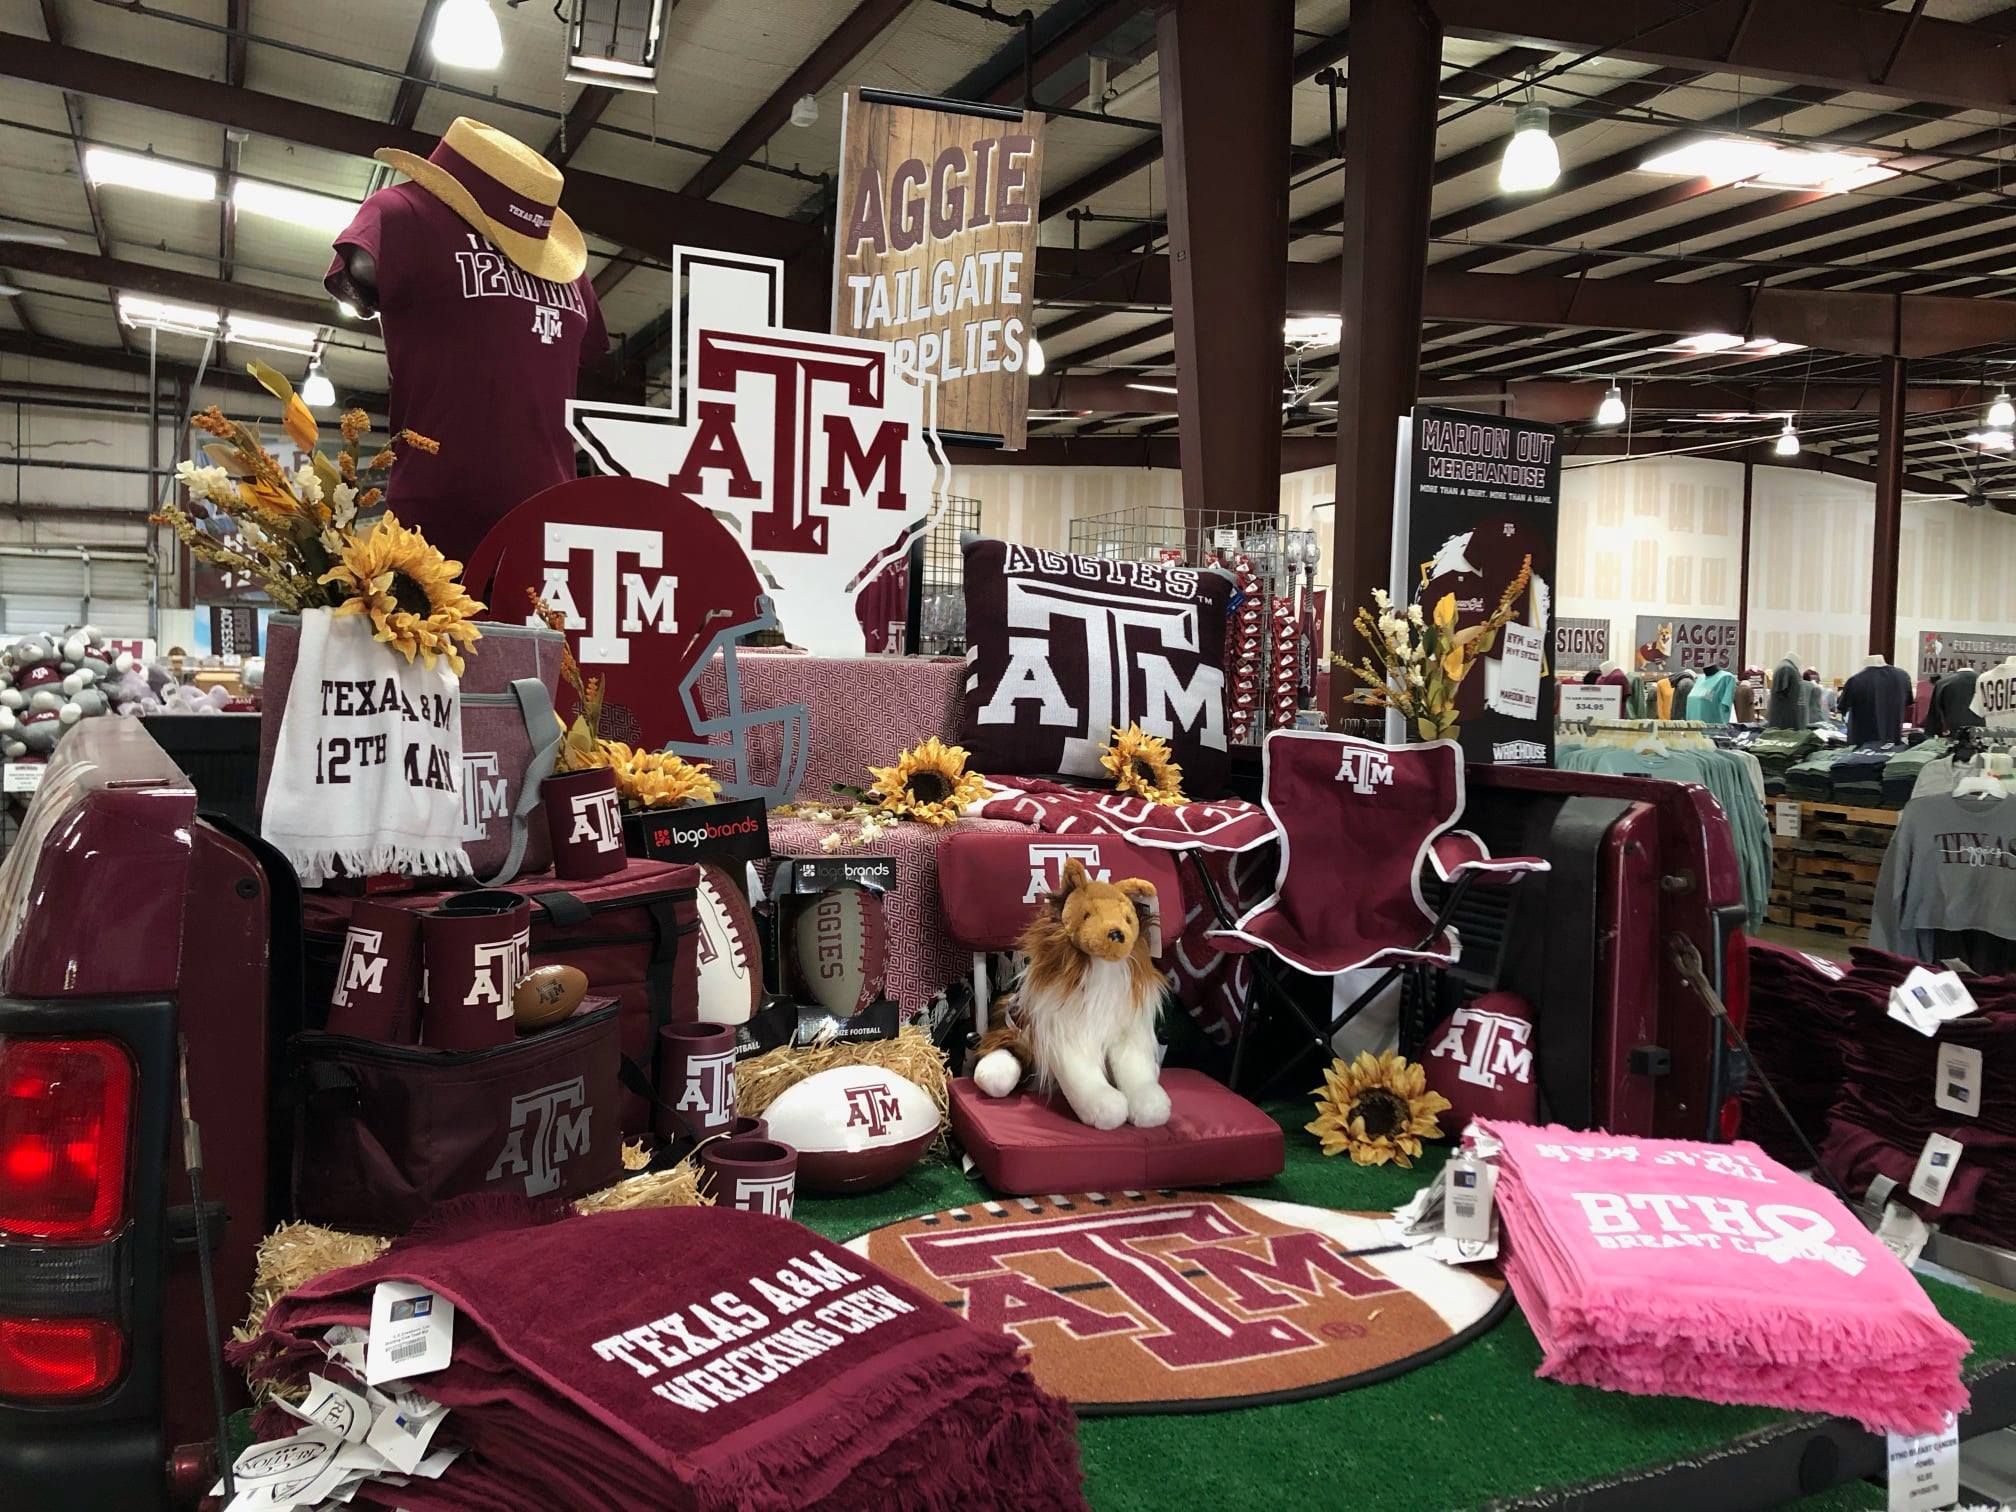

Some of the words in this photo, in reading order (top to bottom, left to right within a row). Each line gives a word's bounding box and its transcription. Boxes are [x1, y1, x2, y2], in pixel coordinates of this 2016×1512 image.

[846, 134, 1035, 258] AGGIE
[509, 204, 534, 222] TEXAS
[848, 251, 1023, 329] TAILGATE
[893, 318, 1024, 382] PPLIES
[1422, 419, 1510, 459] MAROON
[1517, 431, 1555, 464] OUT
[1428, 457, 1546, 488] MERCHANDISE
[1420, 484, 1438, 494] MORE
[1440, 486, 1458, 495] THAN
[1490, 491, 1507, 500] MORE
[1509, 493, 1526, 501] THAN
[1534, 496, 1553, 504] GAME.
[1003, 542, 1199, 598] AGGIES
[220, 607, 235, 655] ACCESSO
[1557, 628, 1605, 654] SIGNS
[1676, 624, 1736, 646] AGGIE
[1681, 647, 1730, 668] PETS
[321, 678, 401, 716] TEXA
[1576, 703, 1604, 711] $34.95
[316, 733, 387, 785] 12TH
[1493, 743, 1546, 760] WAREHOUSE
[672, 816, 759, 848] logobrands
[818, 863, 890, 878] logobrands
[850, 1027, 882, 1037] FOOTBALL
[734, 1041, 761, 1055] OTBALL
[1594, 1234, 1723, 1250] BREAST
[592, 1291, 770, 1378] TEXAS
[749, 1250, 861, 1315] A&M
[652, 1319, 844, 1413] WRECKING
[815, 1285, 916, 1334] CREW
[1933, 1438, 1957, 1452] CANCER
